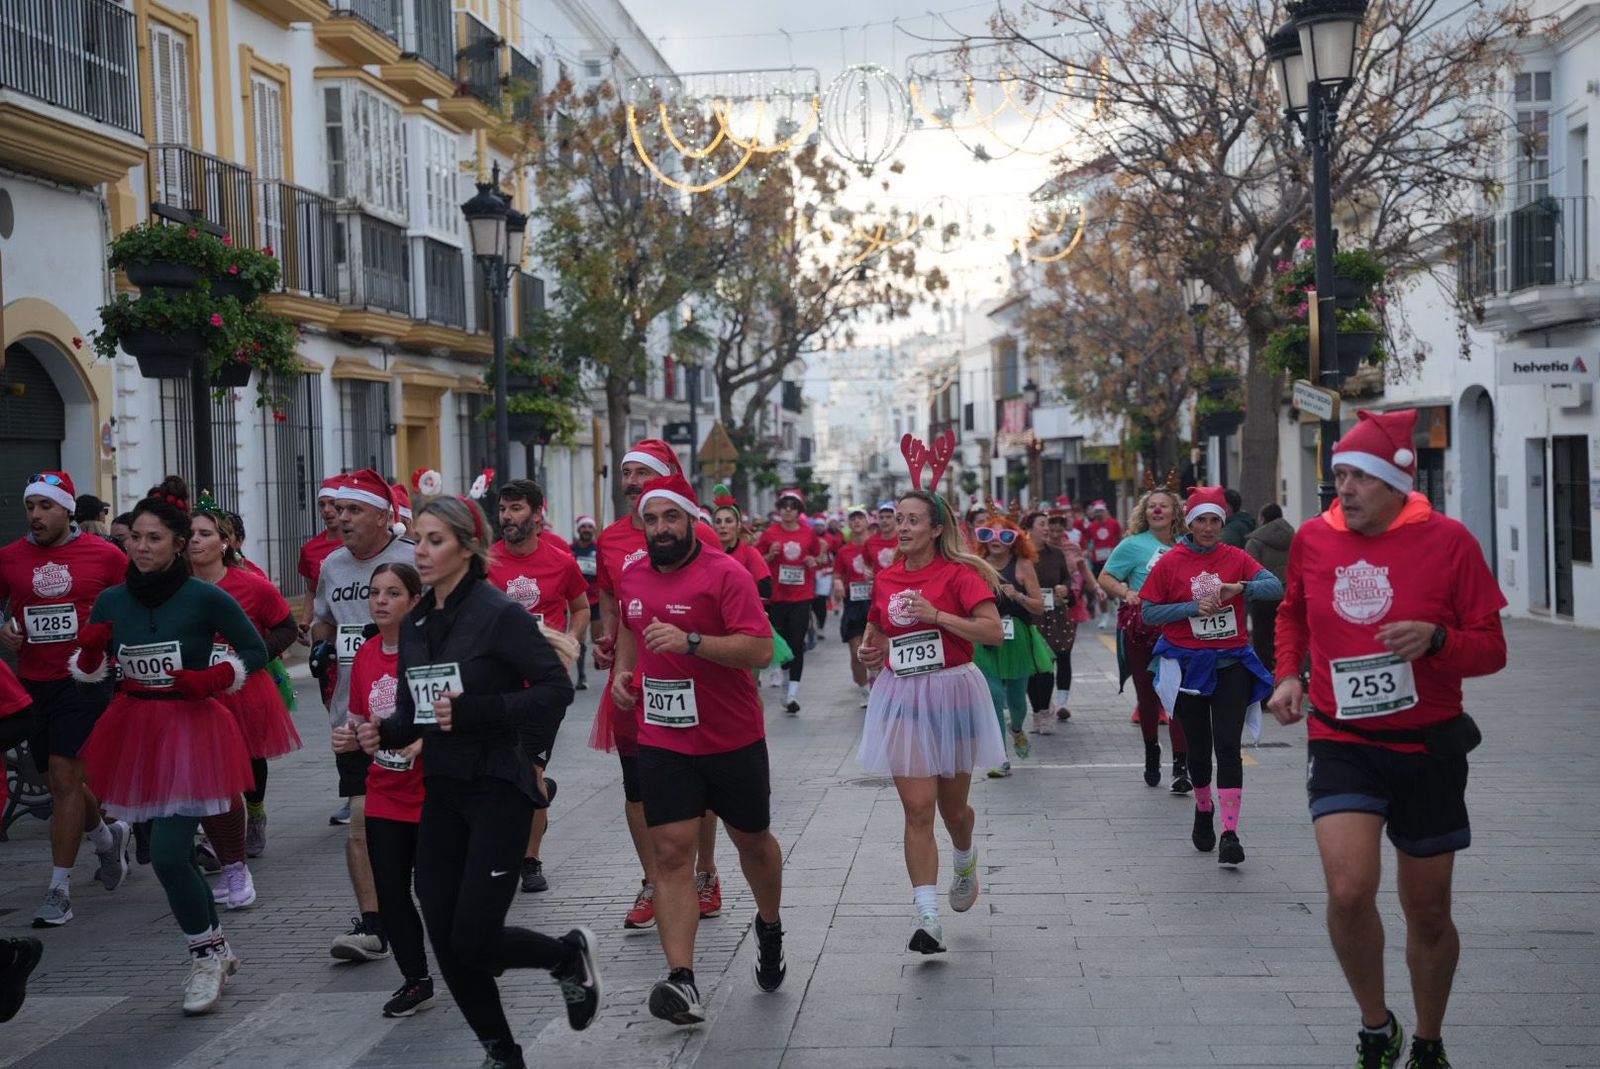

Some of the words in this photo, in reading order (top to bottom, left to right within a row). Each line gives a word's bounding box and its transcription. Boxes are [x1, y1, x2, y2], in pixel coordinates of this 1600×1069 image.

[1513, 361, 1569, 373] helvetia
[1335, 566, 1389, 577] Carrera
[1350, 578, 1377, 589] San
[1335, 588, 1394, 602] Silvestre
[33, 615, 72, 632] 1285
[1200, 615, 1227, 631] 715
[897, 644, 937, 664] 1793
[127, 657, 174, 675] 1006
[1348, 672, 1396, 698] 253
[647, 692, 686, 711] 2071
